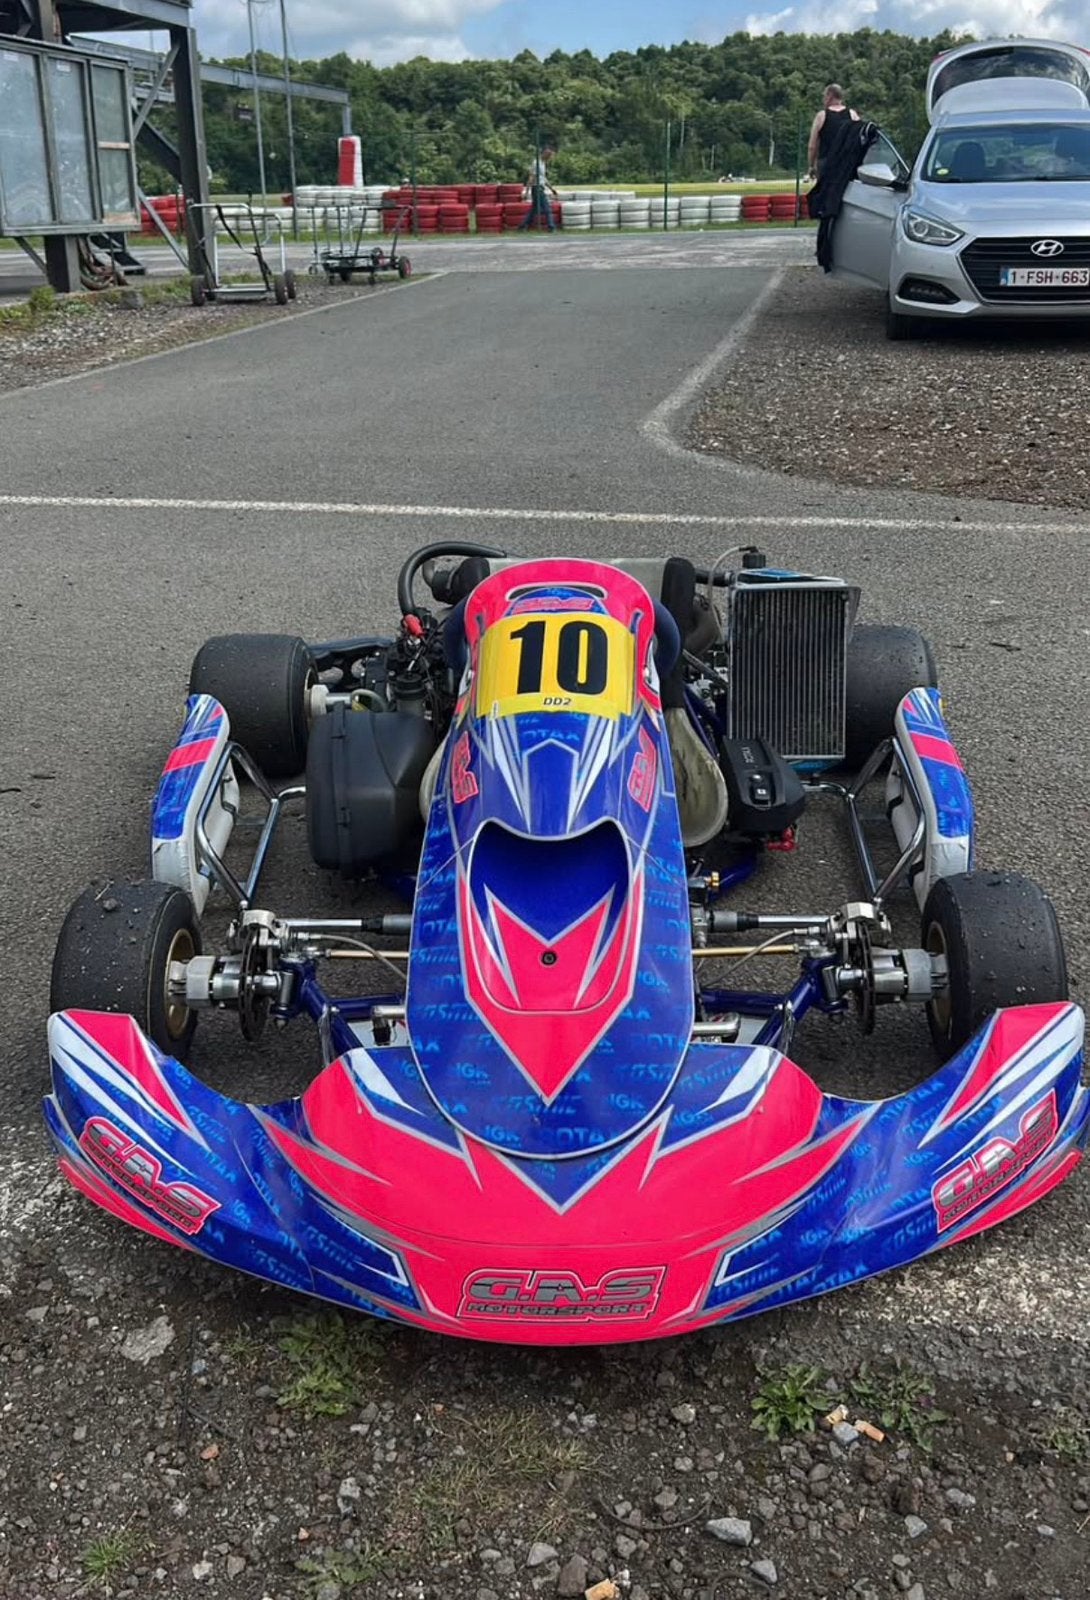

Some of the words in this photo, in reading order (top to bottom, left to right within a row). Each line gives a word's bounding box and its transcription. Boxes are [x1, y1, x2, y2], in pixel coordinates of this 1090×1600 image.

[1011, 270, 1088, 284] 1-FSH-663
[510, 620, 608, 695] 10
[543, 697, 572, 706] DD2
